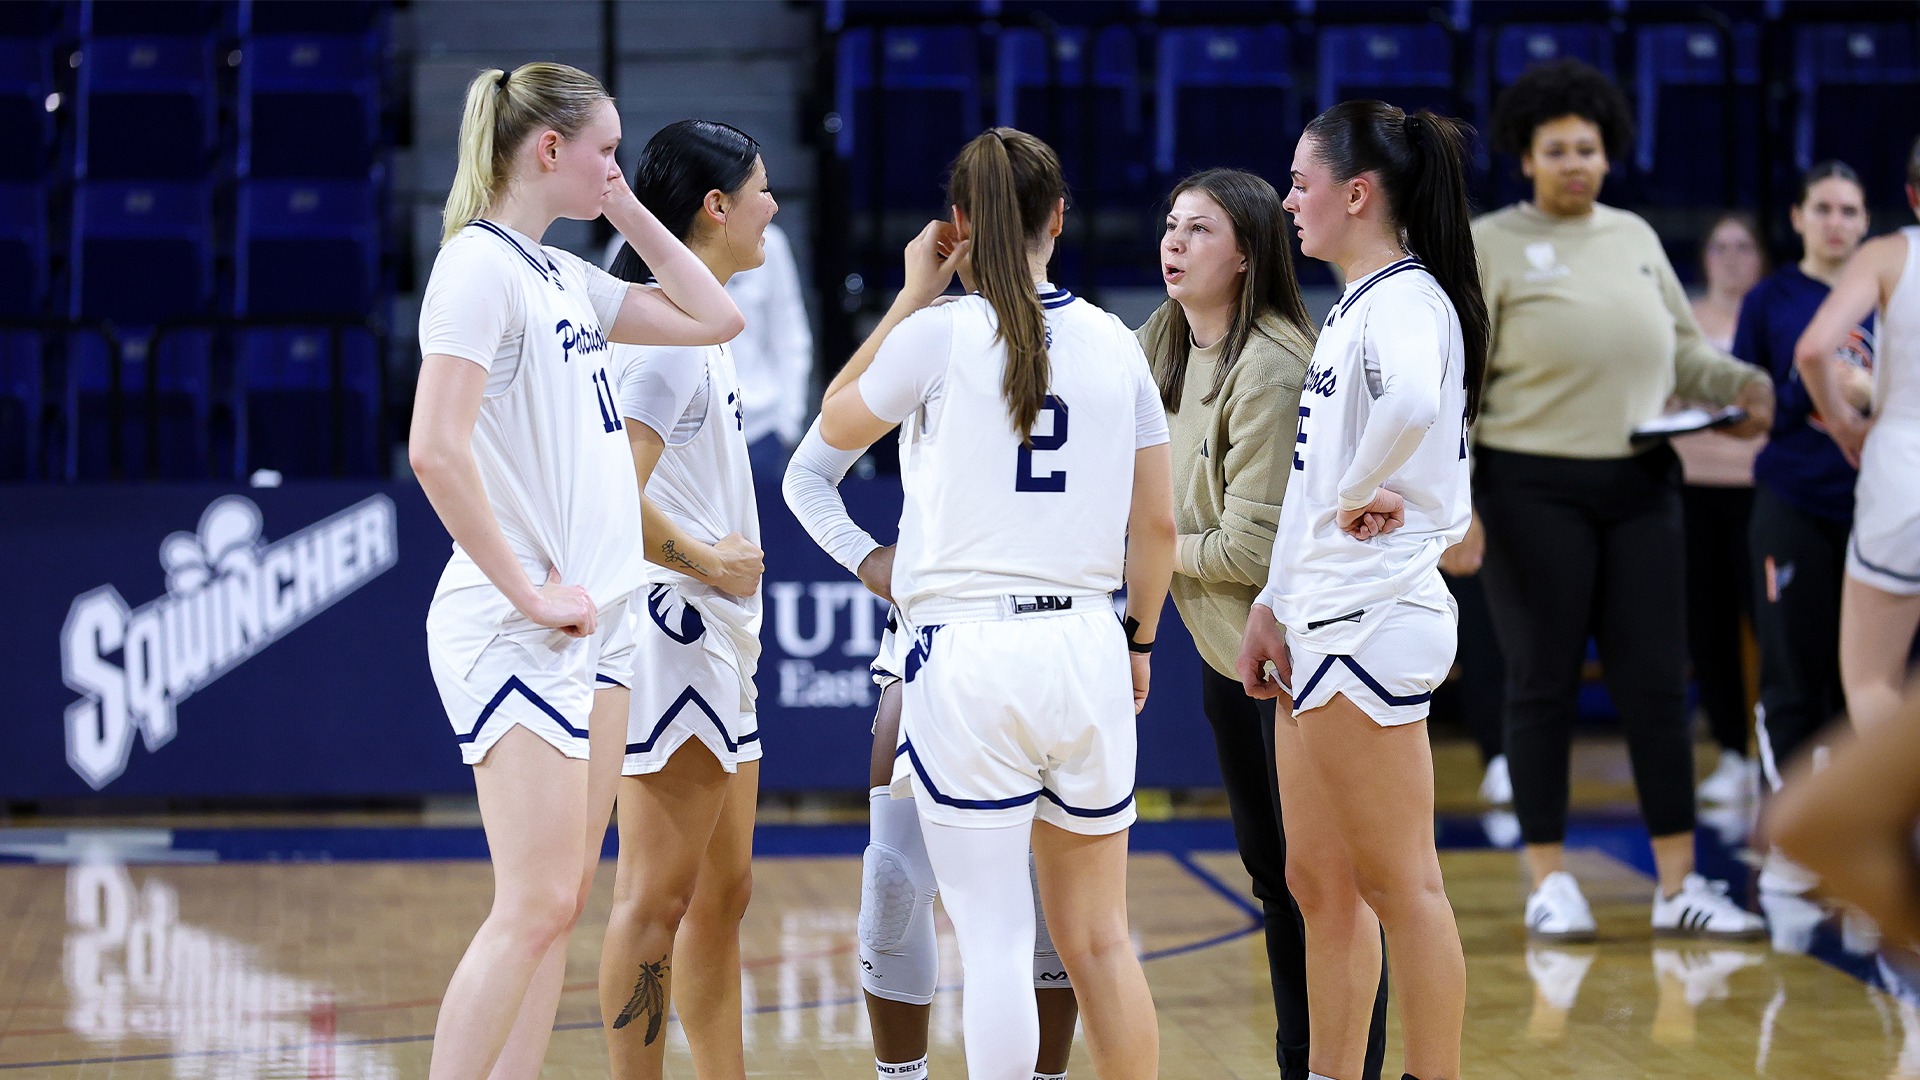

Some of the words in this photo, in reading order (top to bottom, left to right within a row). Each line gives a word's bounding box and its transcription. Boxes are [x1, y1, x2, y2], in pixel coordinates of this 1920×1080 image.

[592, 367, 623, 434] 11
[1015, 394, 1069, 493] 2
[899, 1062, 923, 1074] SELF
